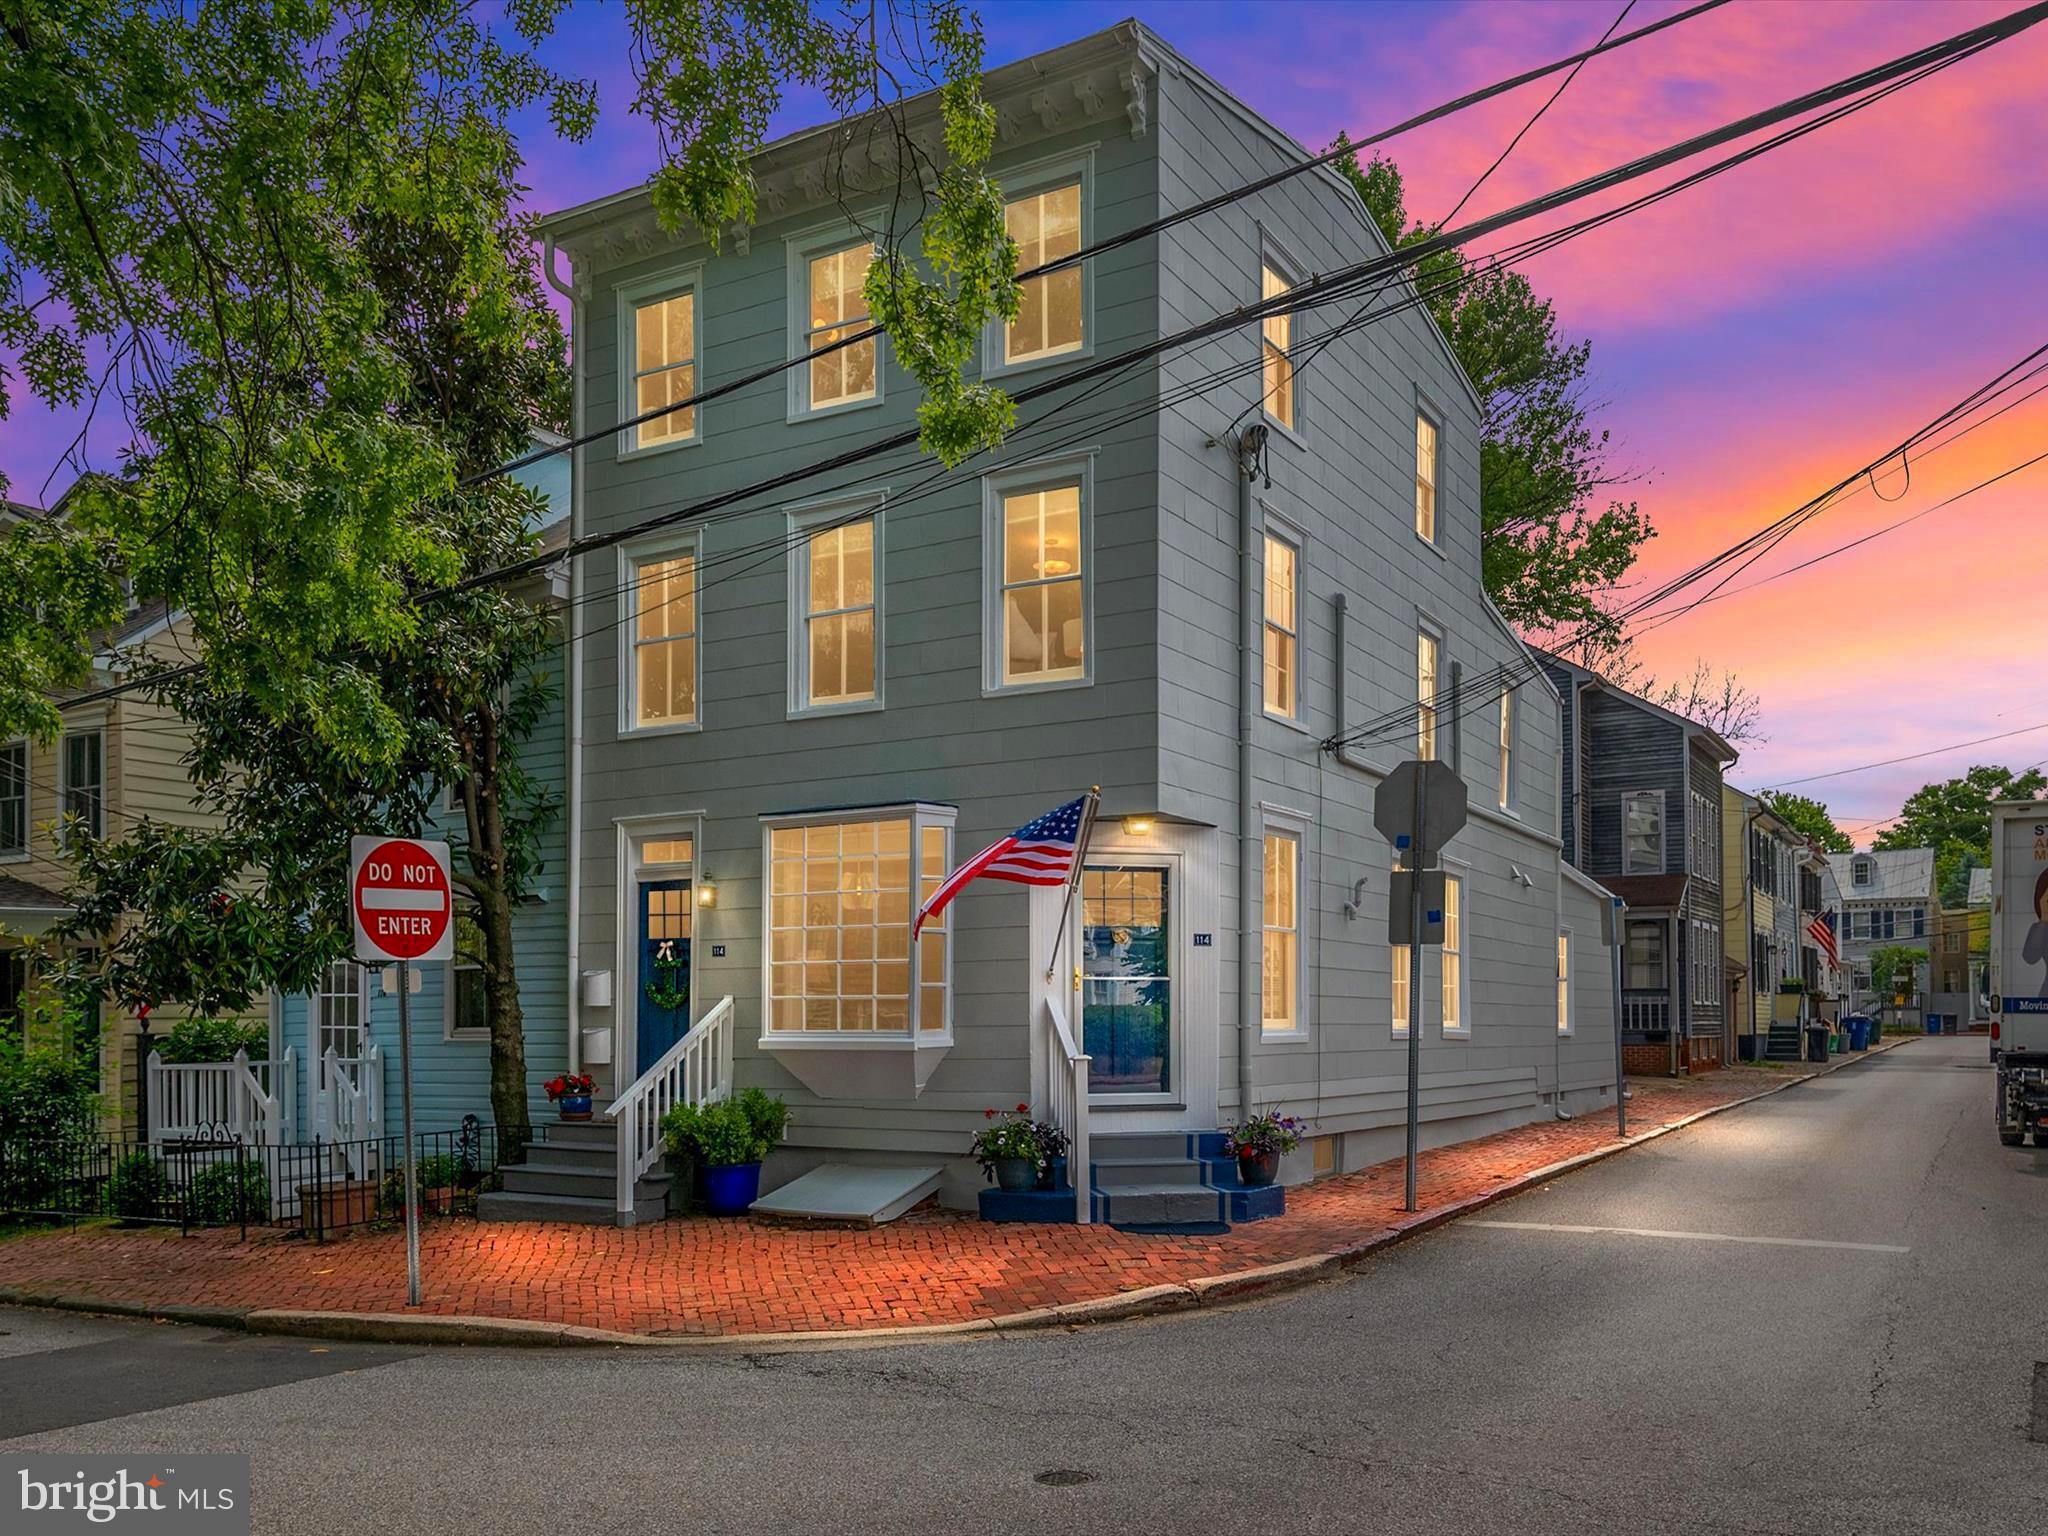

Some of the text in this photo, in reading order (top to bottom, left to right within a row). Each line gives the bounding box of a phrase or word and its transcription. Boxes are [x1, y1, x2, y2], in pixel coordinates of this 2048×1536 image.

[2033, 838, 2048, 849] A
[2034, 850, 2048, 861] M
[368, 862, 436, 884] DO NOT
[377, 916, 432, 935] ENTER
[1195, 935, 1210, 945] 114
[713, 946, 724, 956] 114
